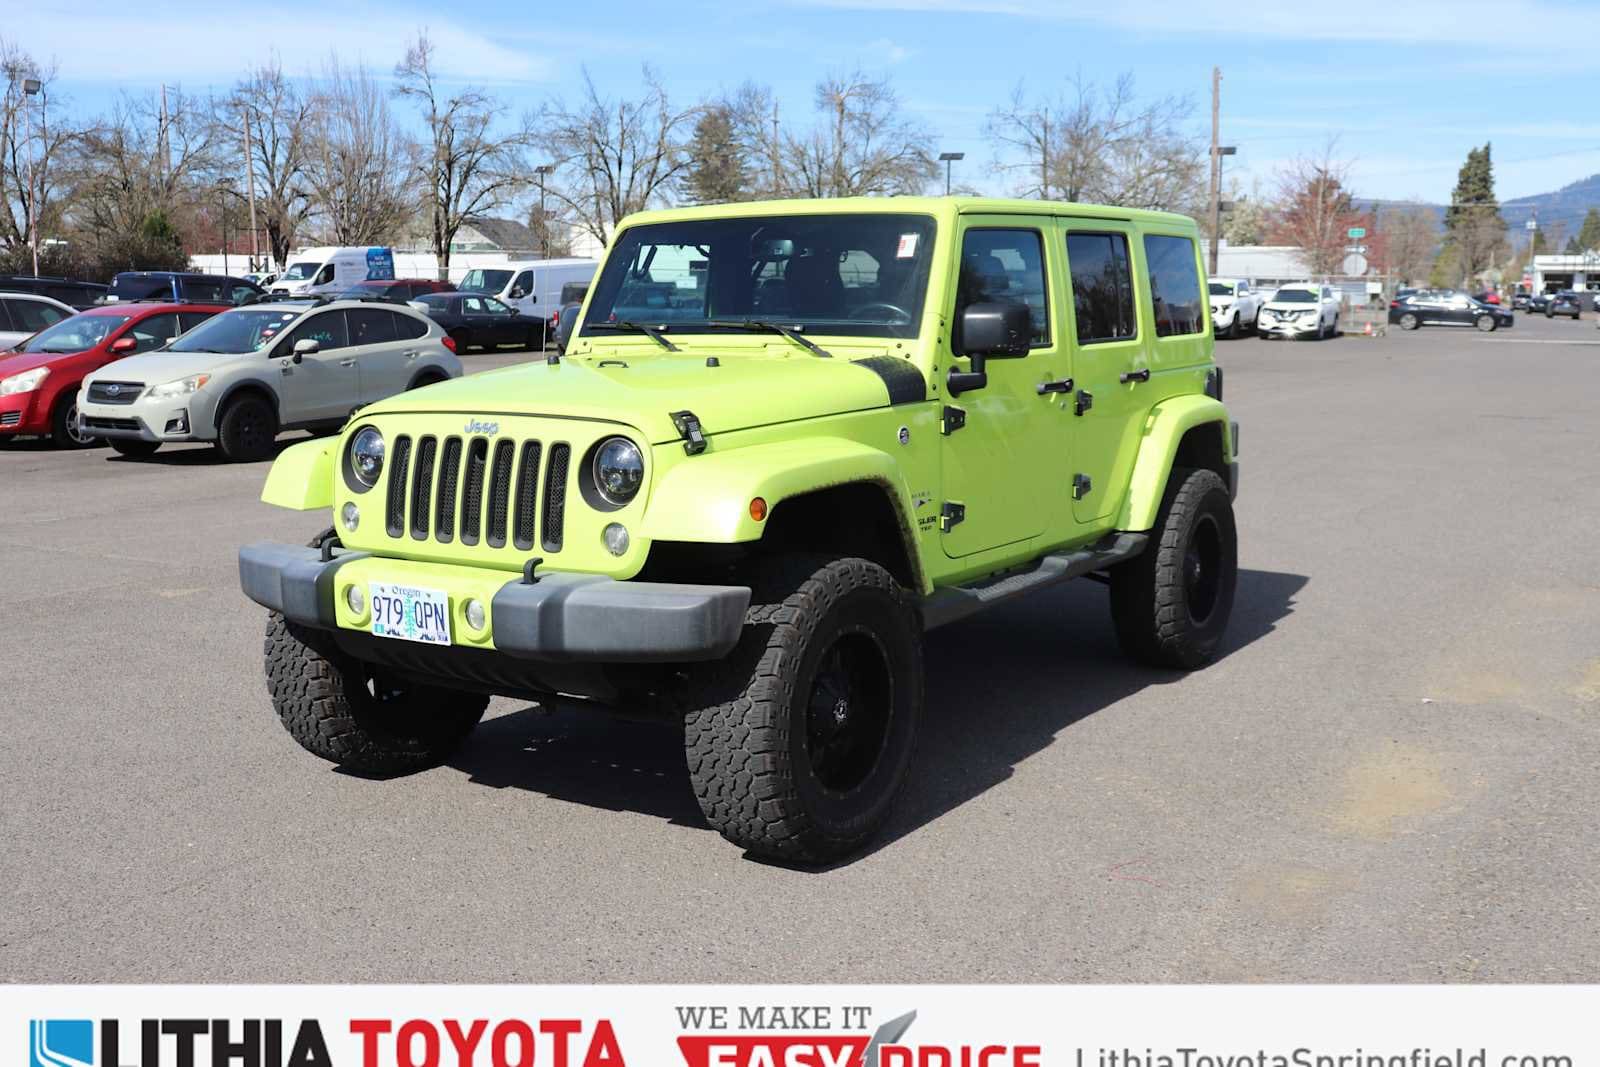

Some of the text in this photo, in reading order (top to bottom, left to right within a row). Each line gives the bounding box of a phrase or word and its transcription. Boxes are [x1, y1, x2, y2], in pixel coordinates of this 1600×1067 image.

[464, 418, 499, 437] Jeep
[392, 585, 420, 598] Oregon
[373, 595, 446, 632] 979 QPN
